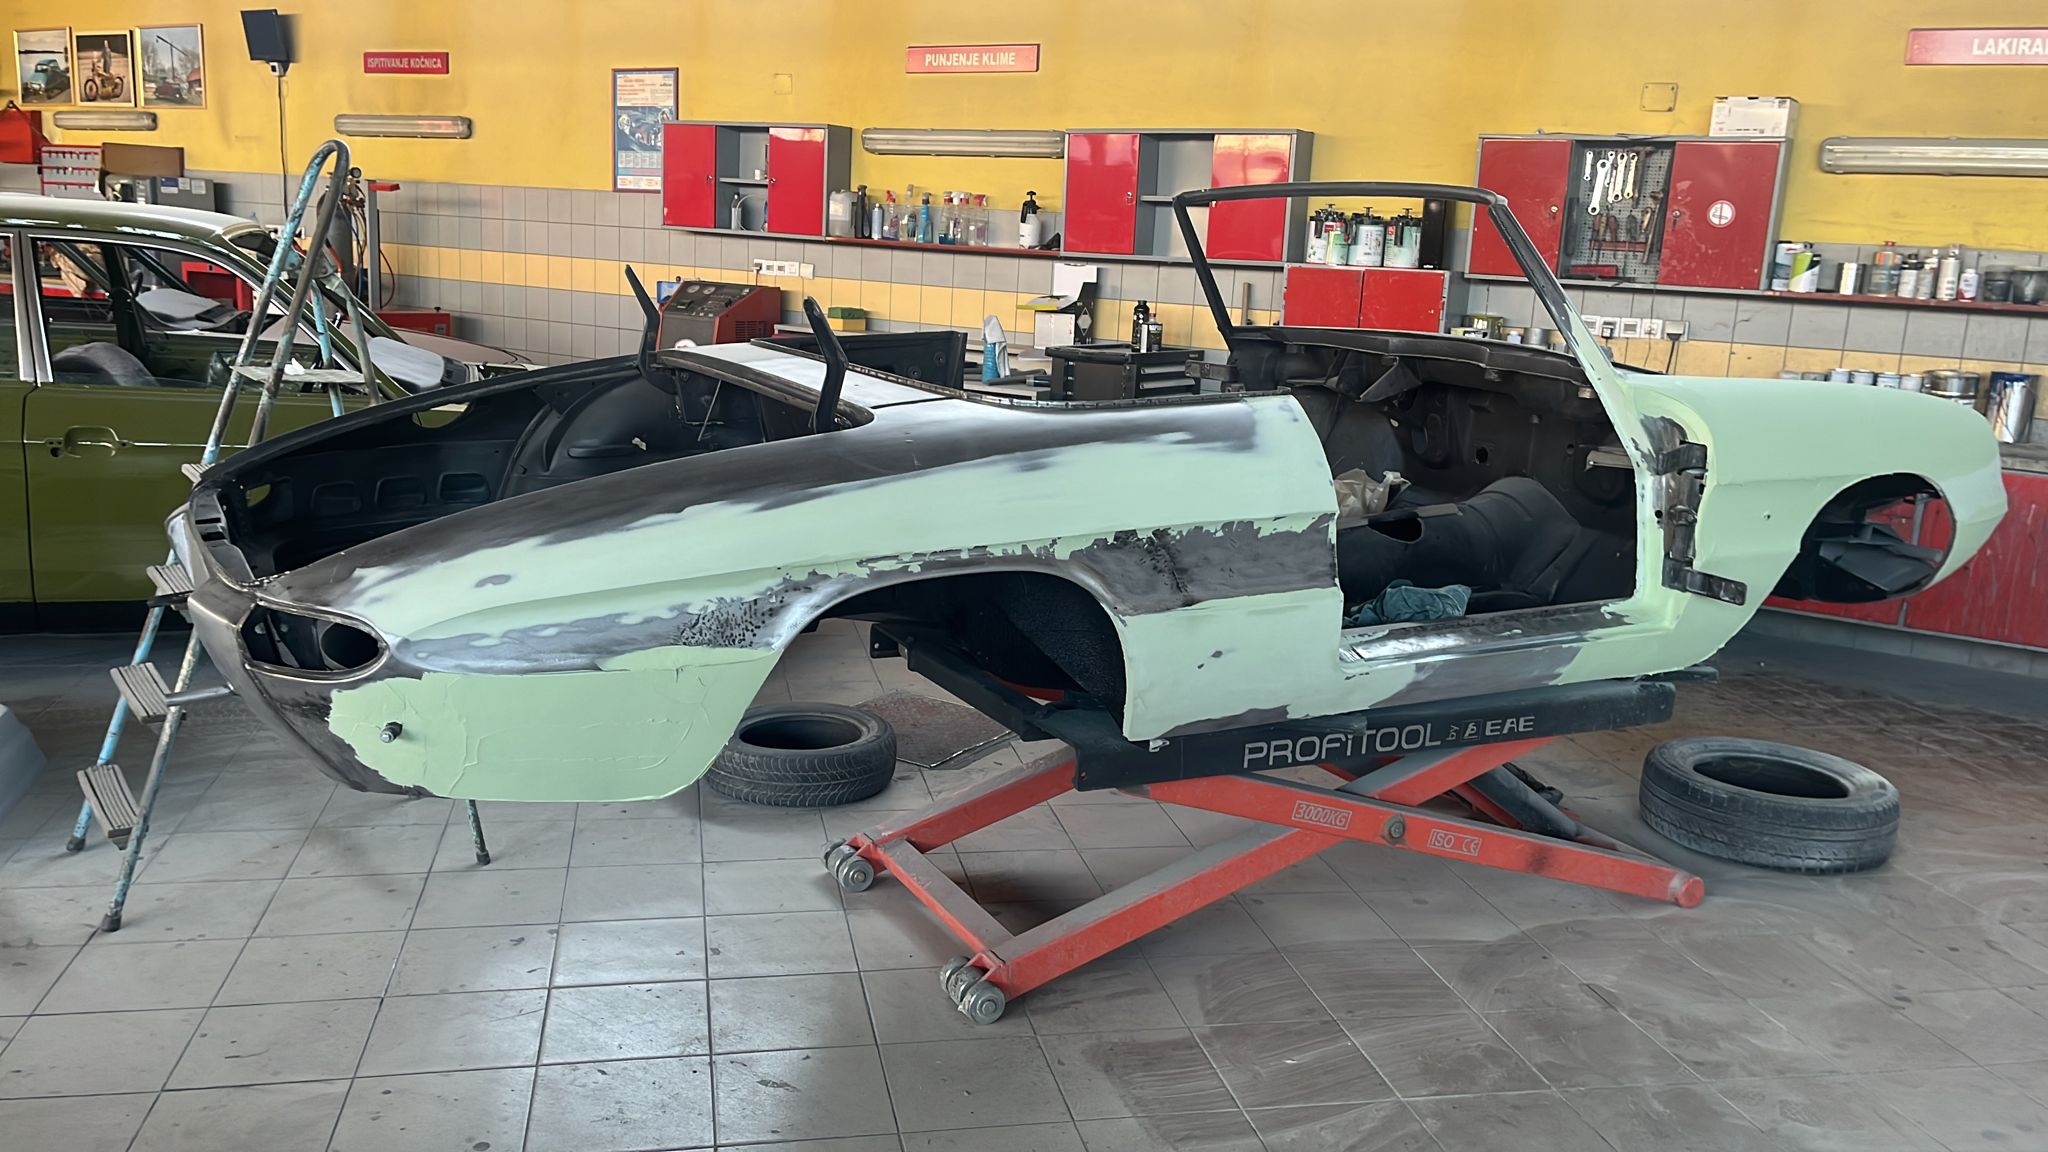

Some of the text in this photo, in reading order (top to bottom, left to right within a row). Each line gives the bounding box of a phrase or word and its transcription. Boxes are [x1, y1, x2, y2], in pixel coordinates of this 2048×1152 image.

[1971, 37, 2048, 56] LAKIRA
[367, 55, 442, 69] ISPITIVANJE KOČNICA
[924, 52, 1016, 67] PUNJENJE KLIME
[1485, 715, 1536, 737] EAE
[1295, 804, 1348, 827] 3000KG
[1432, 831, 1455, 849] ISO
